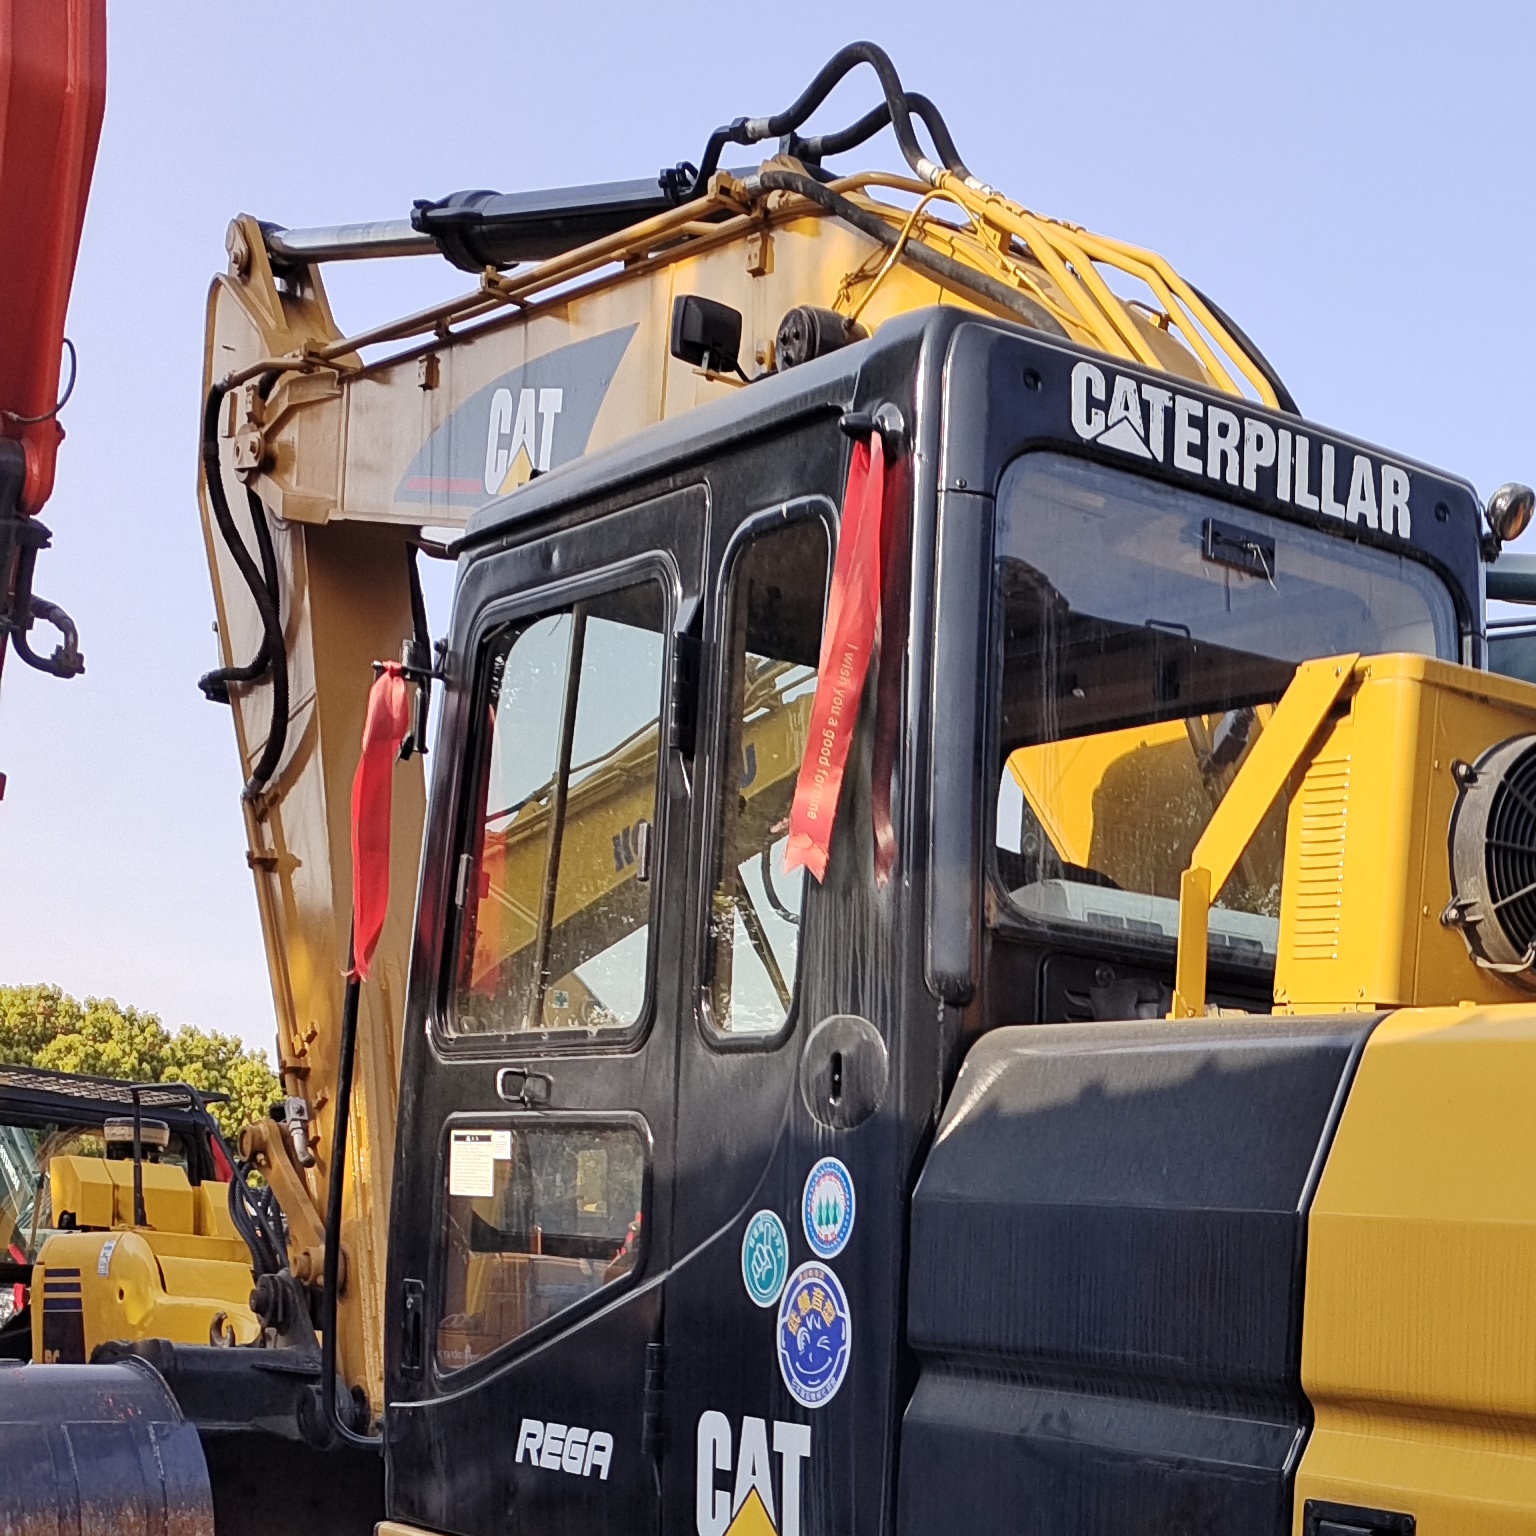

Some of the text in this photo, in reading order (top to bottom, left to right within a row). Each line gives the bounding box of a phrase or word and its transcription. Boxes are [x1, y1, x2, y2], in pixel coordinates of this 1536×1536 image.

[485, 388, 563, 494] CAT
[1071, 361, 1412, 539] CATERPILLAR
[838, 652, 854, 684] wish
[828, 717, 839, 727] a
[832, 686, 846, 716] you
[818, 729, 836, 768] good
[807, 768, 830, 820] forune
[515, 1418, 614, 1480] REGA
